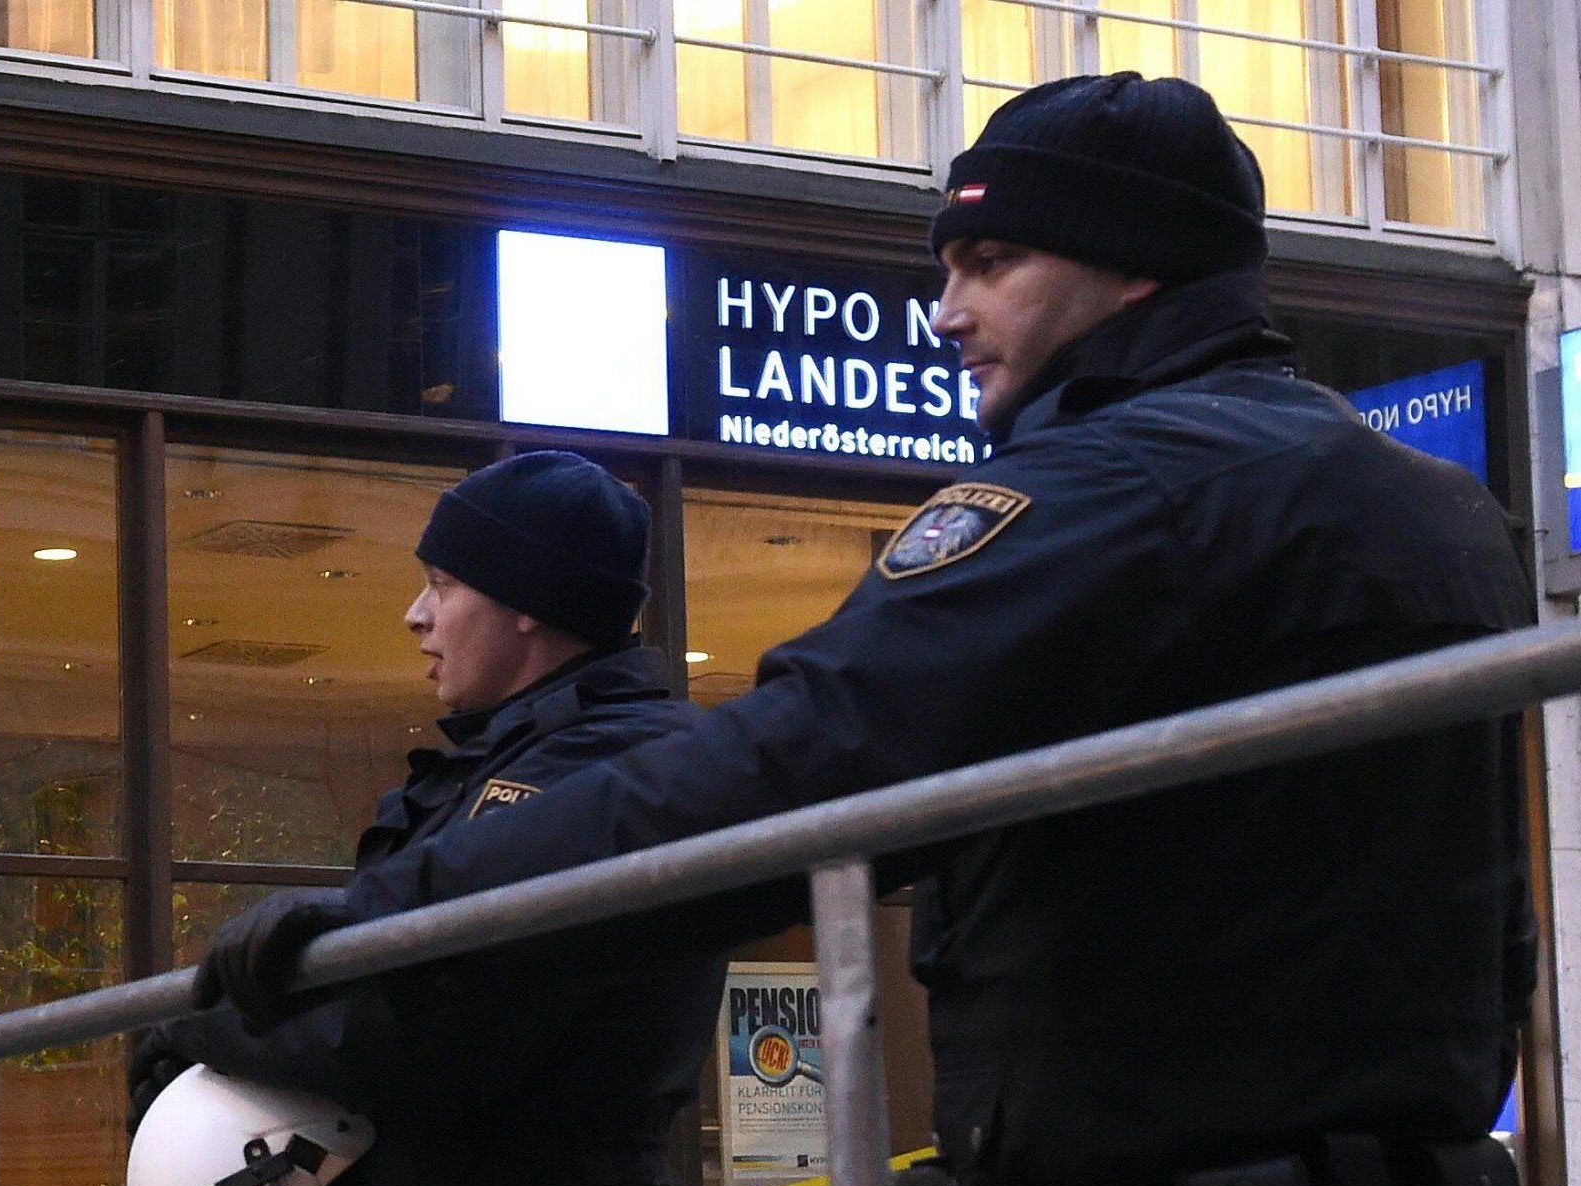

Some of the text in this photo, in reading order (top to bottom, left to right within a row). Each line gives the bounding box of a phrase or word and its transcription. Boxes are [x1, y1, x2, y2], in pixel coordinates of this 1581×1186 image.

[717, 278, 880, 342] HYPO
[720, 415, 975, 463] Niederösterreich
[730, 987, 821, 1036] PENSIO
[737, 1085, 797, 1098] KLARHEIT
[738, 1102, 824, 1115] PENSIONSKON
